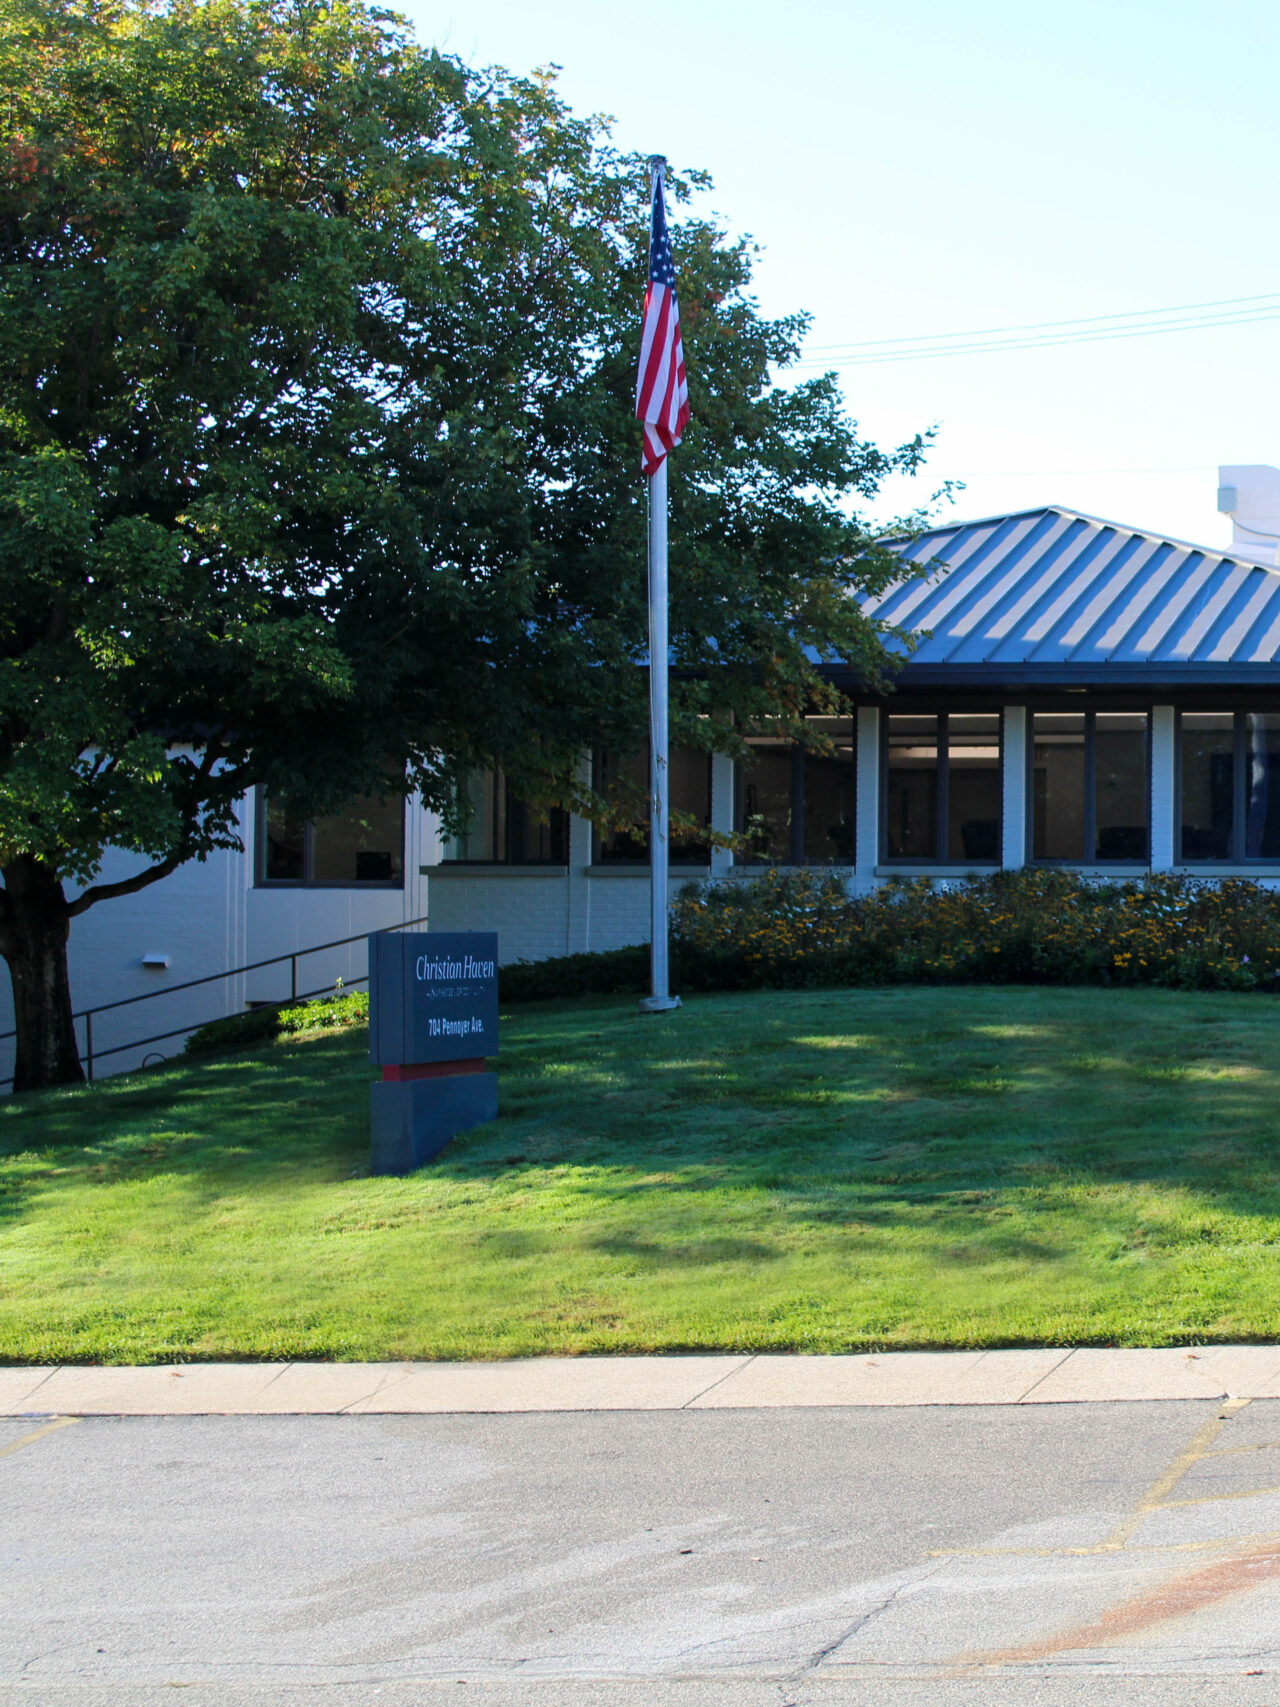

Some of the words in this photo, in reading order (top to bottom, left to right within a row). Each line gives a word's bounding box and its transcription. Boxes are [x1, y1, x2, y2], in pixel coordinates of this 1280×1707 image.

[416, 954, 462, 980] Christian
[463, 954, 494, 978] Haven
[428, 1018, 441, 1036] 704
[442, 1017, 470, 1037] Pennoyer
[471, 1016, 484, 1032] Ave.
